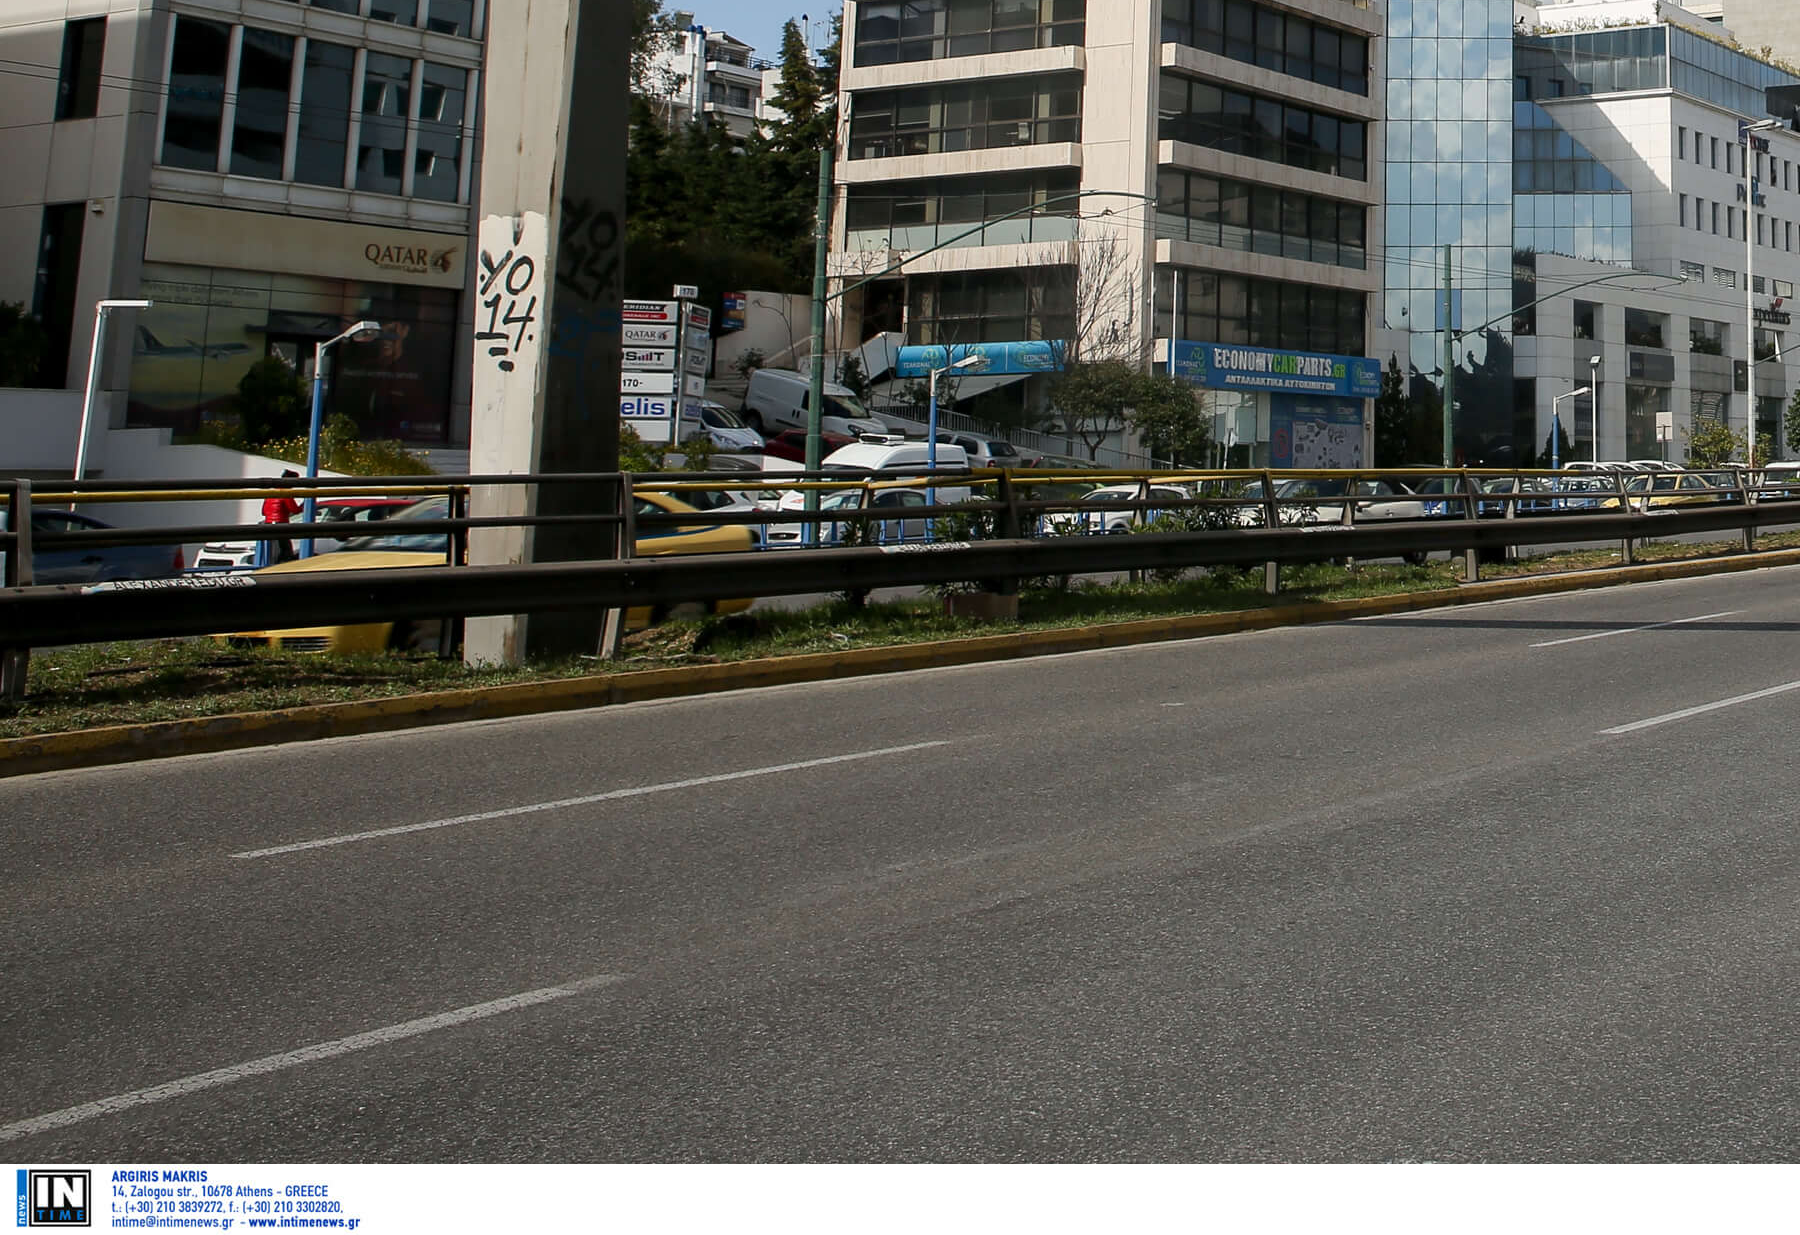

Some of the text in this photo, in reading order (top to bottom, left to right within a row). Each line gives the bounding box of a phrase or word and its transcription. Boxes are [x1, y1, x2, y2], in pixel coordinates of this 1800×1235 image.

[364, 243, 428, 266] QATAR
[624, 330, 657, 340] QATAR
[1213, 347, 1347, 379] ECONOMYCARPARTS.GR
[620, 397, 665, 416] elis
